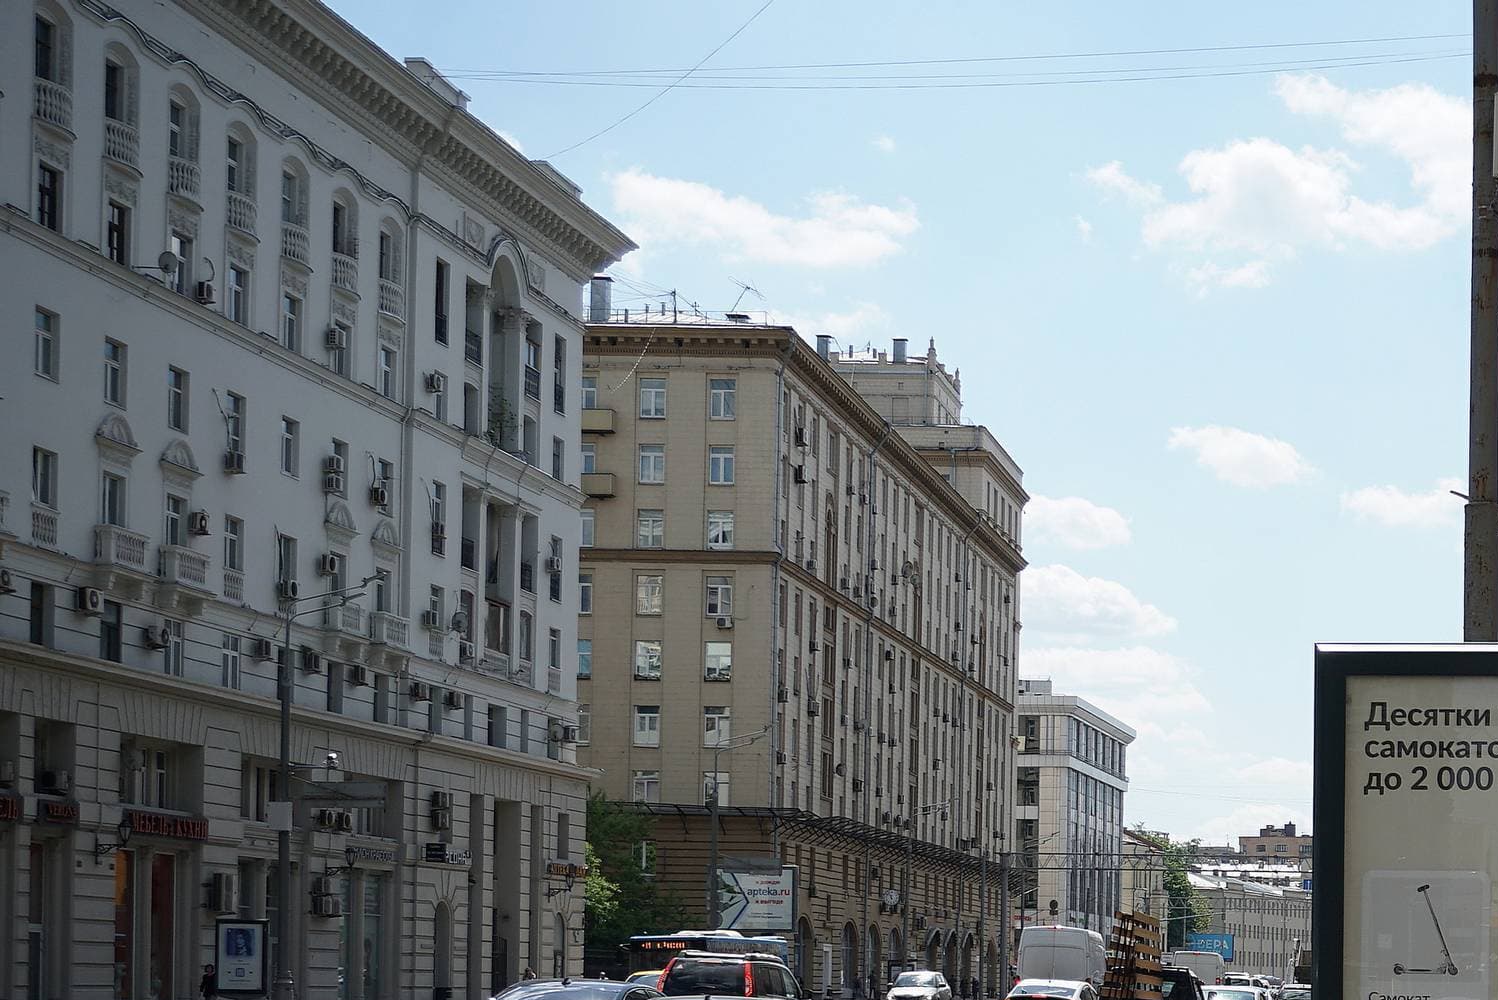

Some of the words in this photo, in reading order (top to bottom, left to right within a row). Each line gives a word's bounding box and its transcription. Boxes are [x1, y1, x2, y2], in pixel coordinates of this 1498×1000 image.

[1363, 701, 1491, 731] Десятки
[1363, 770, 1402, 795] до
[747, 886, 791, 898] apteka.ru
